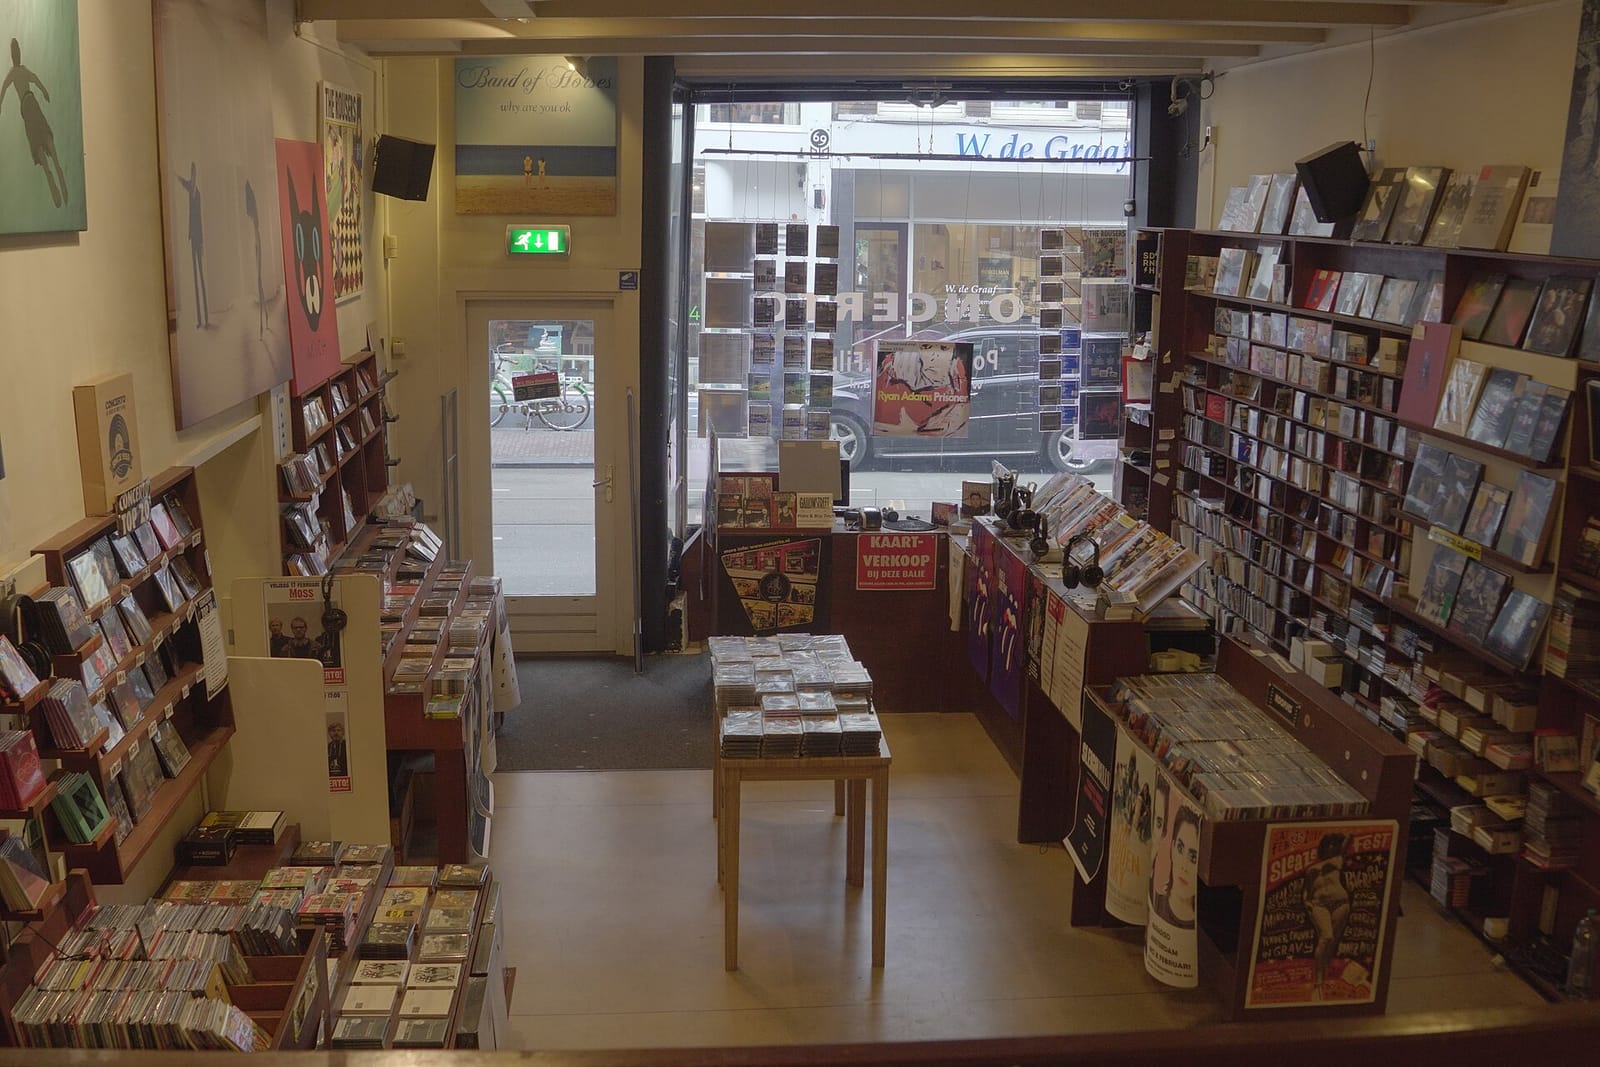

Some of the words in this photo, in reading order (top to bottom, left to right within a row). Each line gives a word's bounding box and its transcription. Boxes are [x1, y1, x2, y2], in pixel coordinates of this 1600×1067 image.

[458, 65, 528, 88] Band
[522, 69, 544, 95] of
[546, 65, 612, 89] Horses
[500, 100, 520, 113] why
[522, 104, 537, 112] are
[539, 104, 557, 113] you
[559, 101, 571, 112] ok
[812, 131, 828, 146] 69
[956, 133, 993, 158] W.
[1000, 133, 1033, 159] de
[945, 285, 957, 293] W.
[959, 285, 969, 293] de
[971, 285, 998, 297] Graaf
[688, 306, 700, 321] 4
[878, 390, 899, 402] Ryan
[901, 390, 932, 401] Adams
[934, 391, 968, 402] Prisoner
[121, 507, 137, 536] TOP
[870, 535, 924, 548] KAART-
[863, 554, 930, 567] VERKOOP
[867, 569, 879, 579] BIJ
[881, 570, 900, 578] DEZE
[902, 570, 926, 578] BALIE
